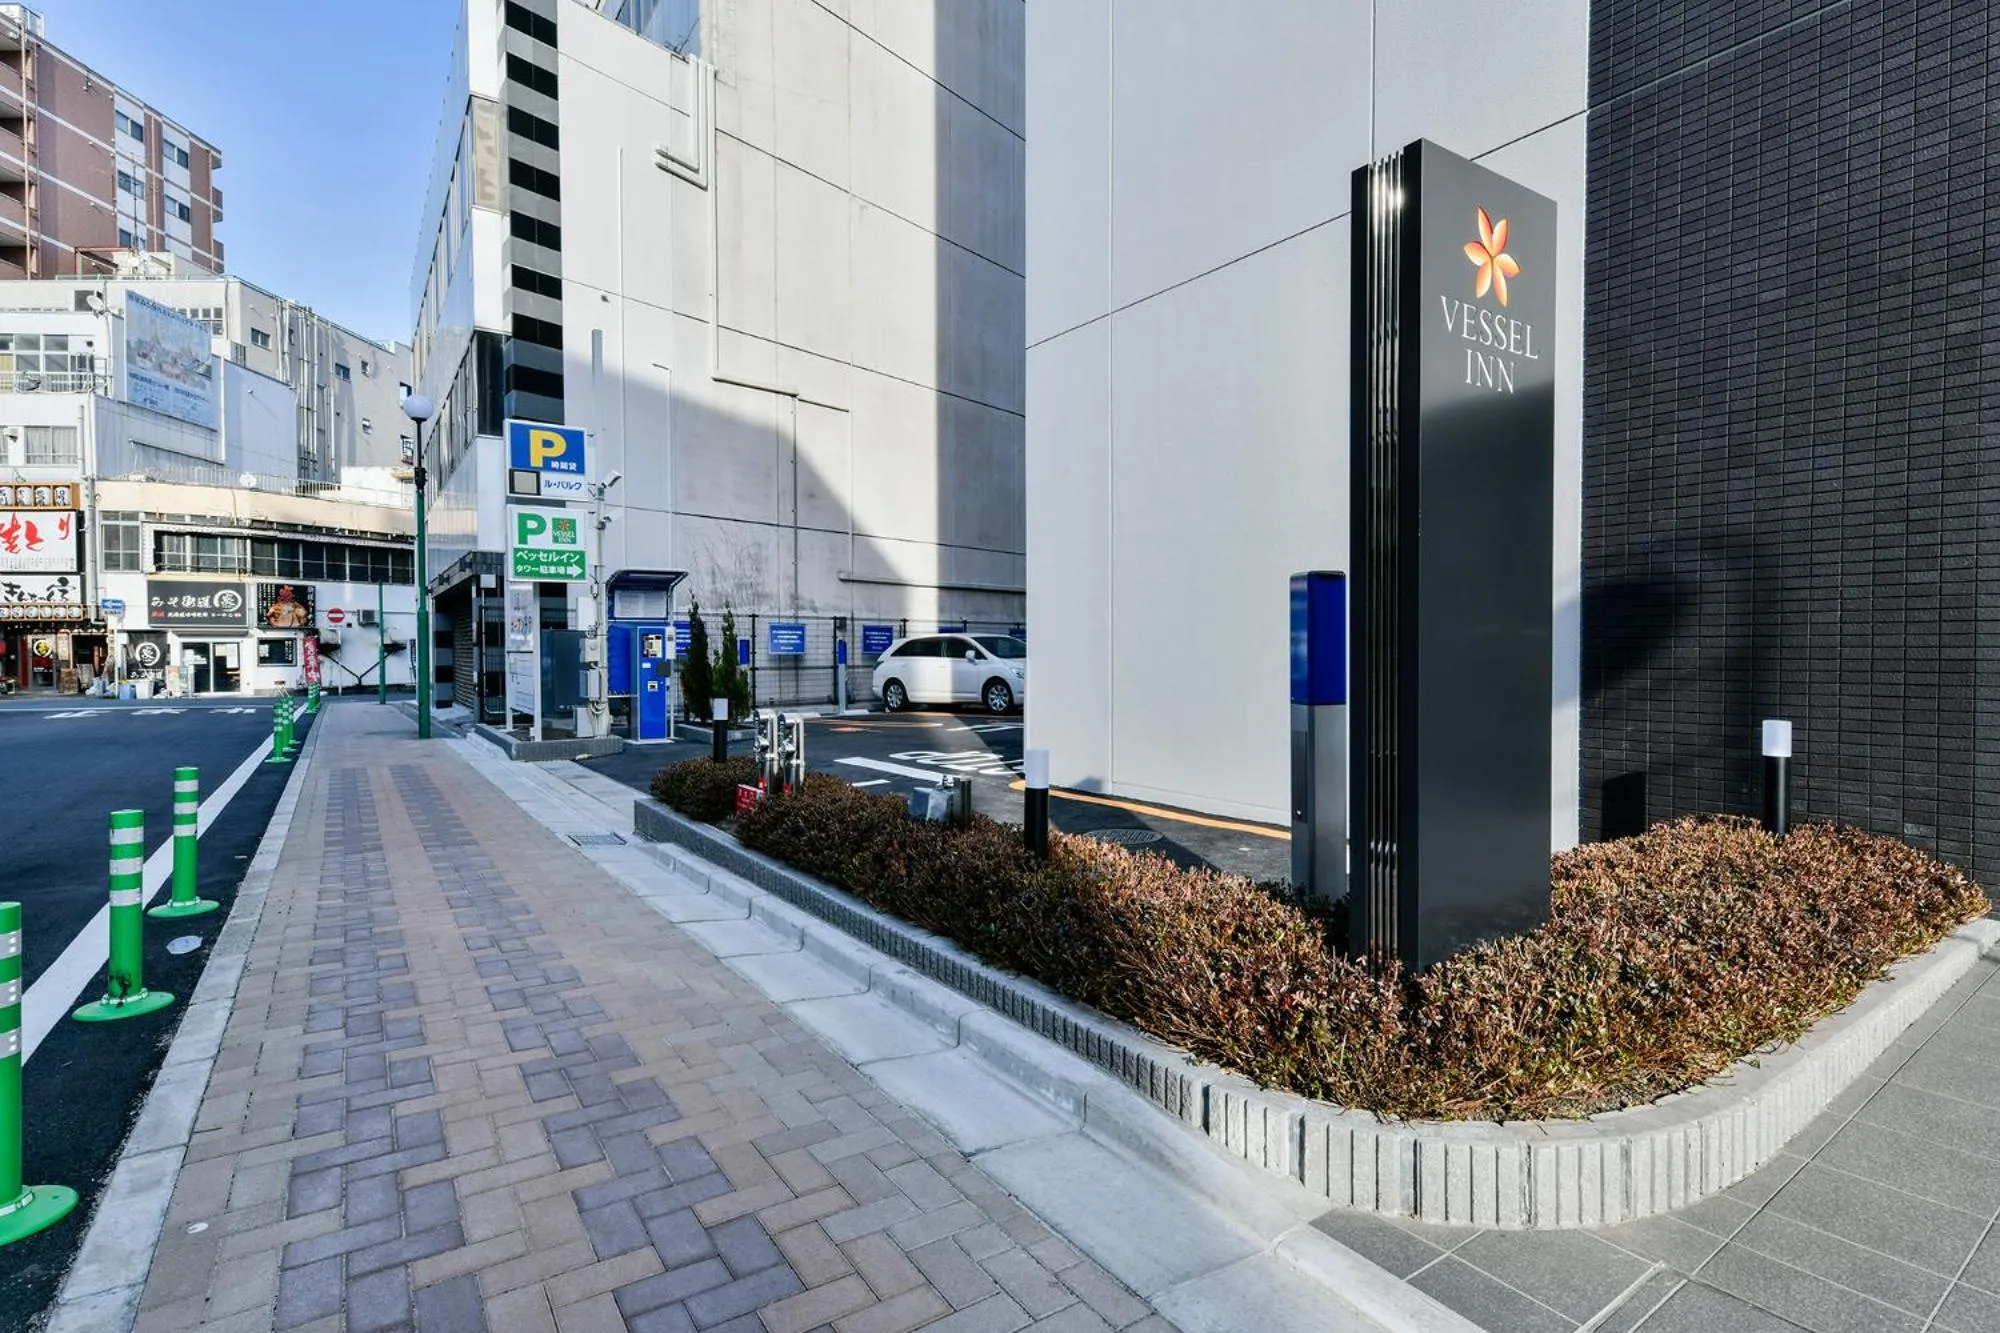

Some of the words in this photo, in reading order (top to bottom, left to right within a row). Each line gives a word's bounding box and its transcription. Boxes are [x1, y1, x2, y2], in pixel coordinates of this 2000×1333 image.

[1440, 295, 1539, 360] VESSEL
[1464, 349, 1515, 394] INN
[530, 429, 567, 467] P
[517, 513, 546, 544] P
[516, 551, 580, 563] ベッセルイン
